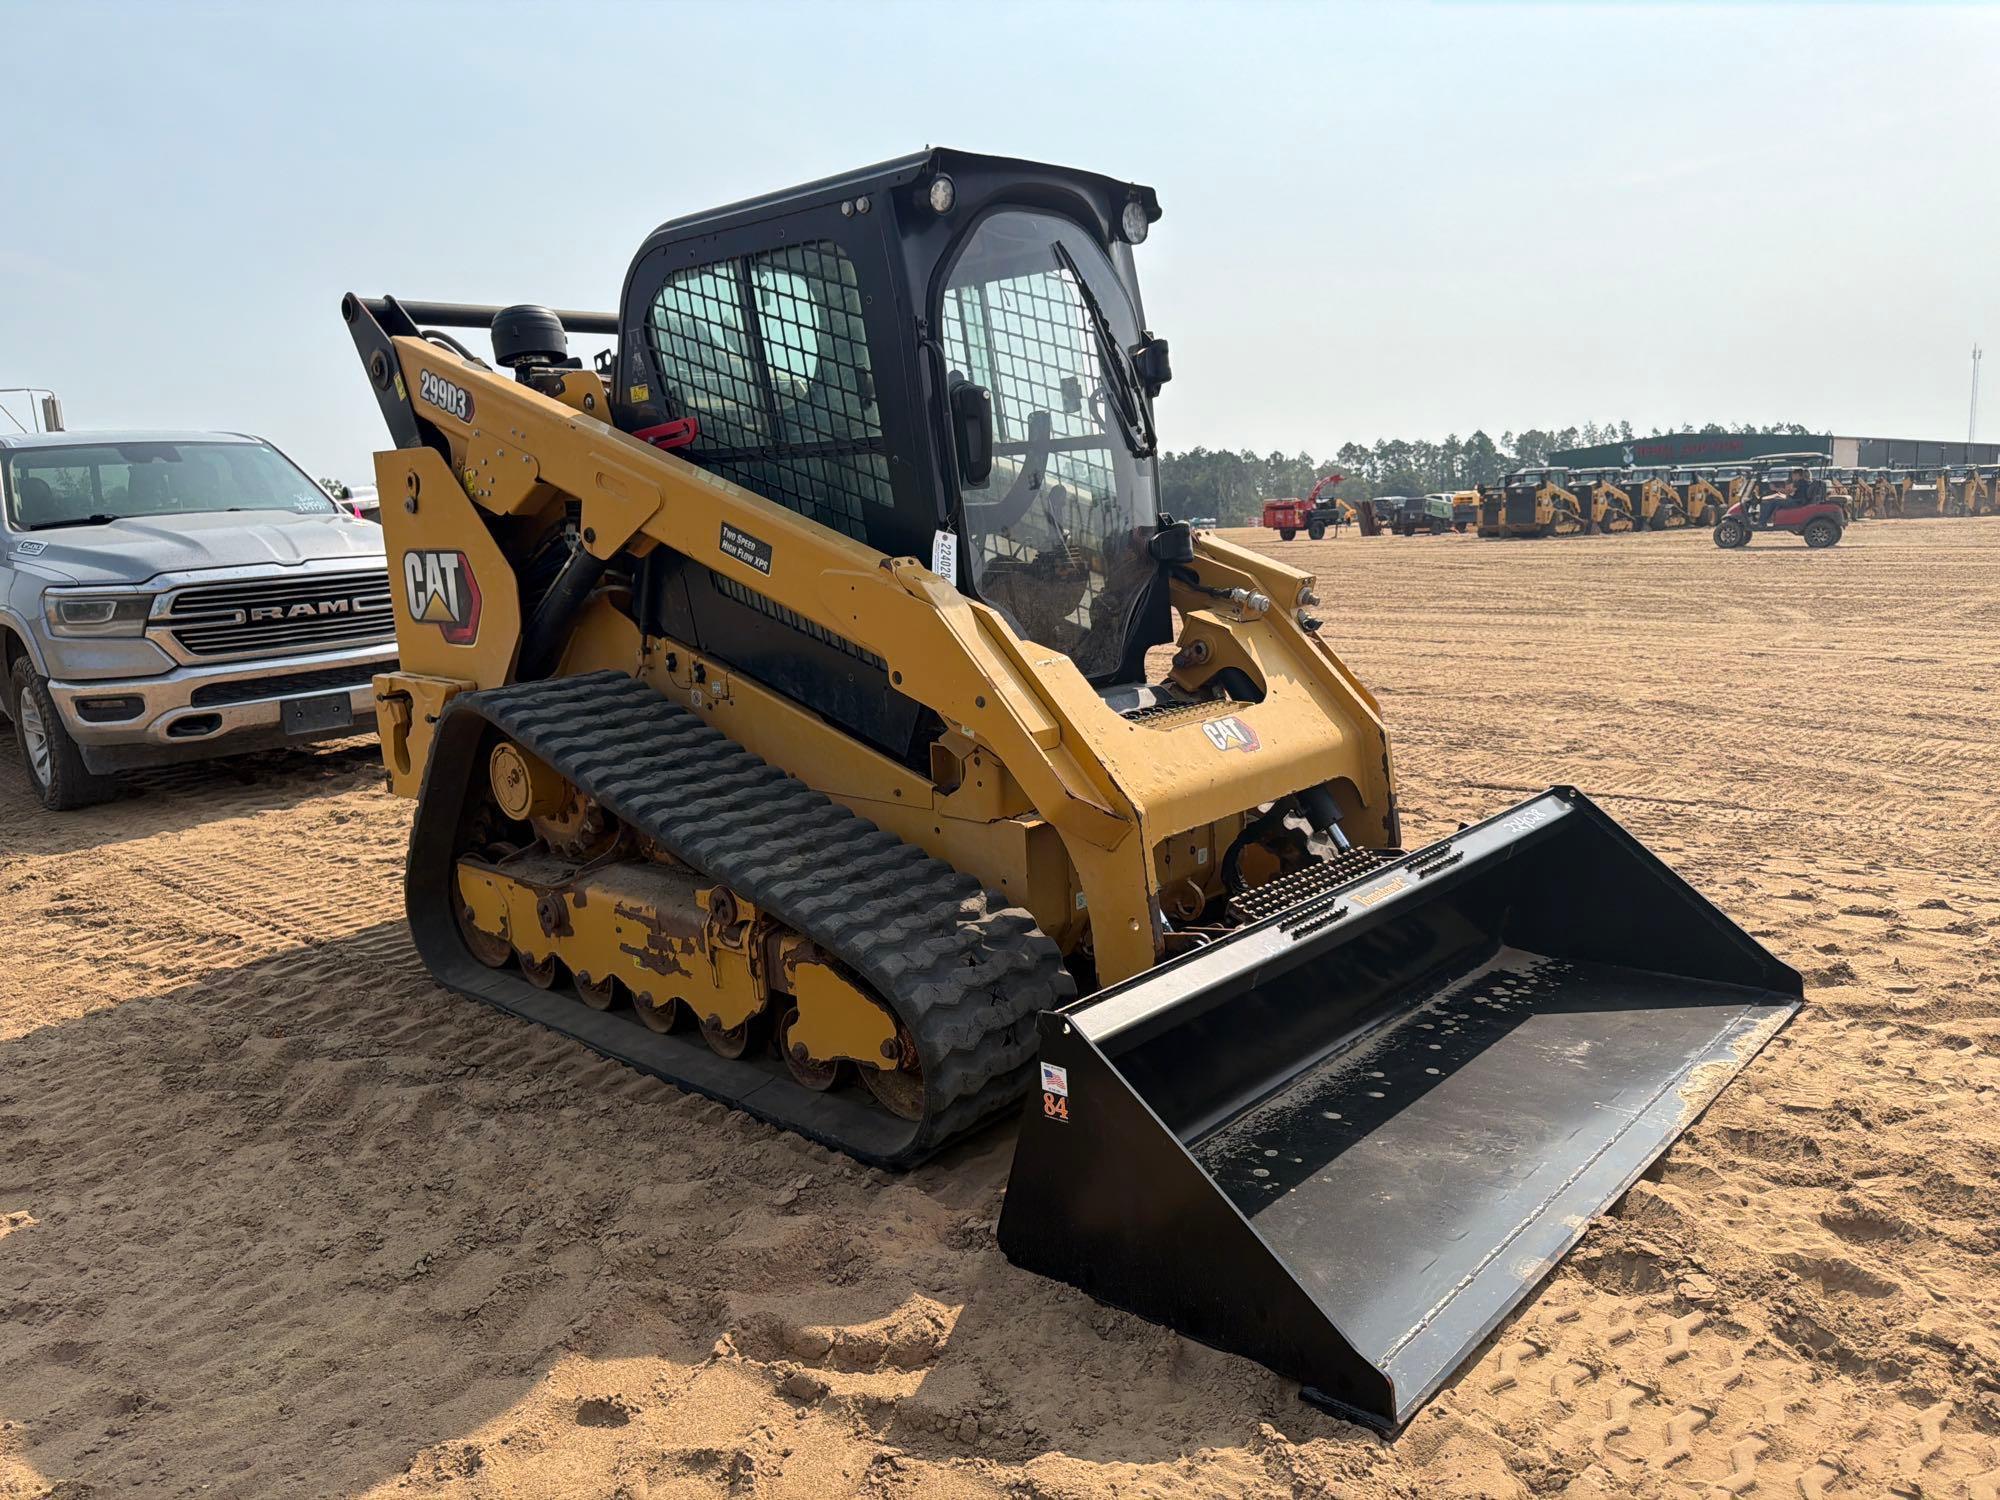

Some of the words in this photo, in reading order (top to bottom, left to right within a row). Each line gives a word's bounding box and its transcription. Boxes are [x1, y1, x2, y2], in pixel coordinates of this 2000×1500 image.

[421, 370, 467, 419] 299D3
[754, 556, 769, 571] XPS
[940, 542, 952, 579] 224028
[404, 552, 460, 622] CAT
[251, 599, 349, 621] RAM
[1202, 717, 1249, 751] CAT
[1503, 808, 1547, 833] 224028
[1043, 1092, 1069, 1119] 84
